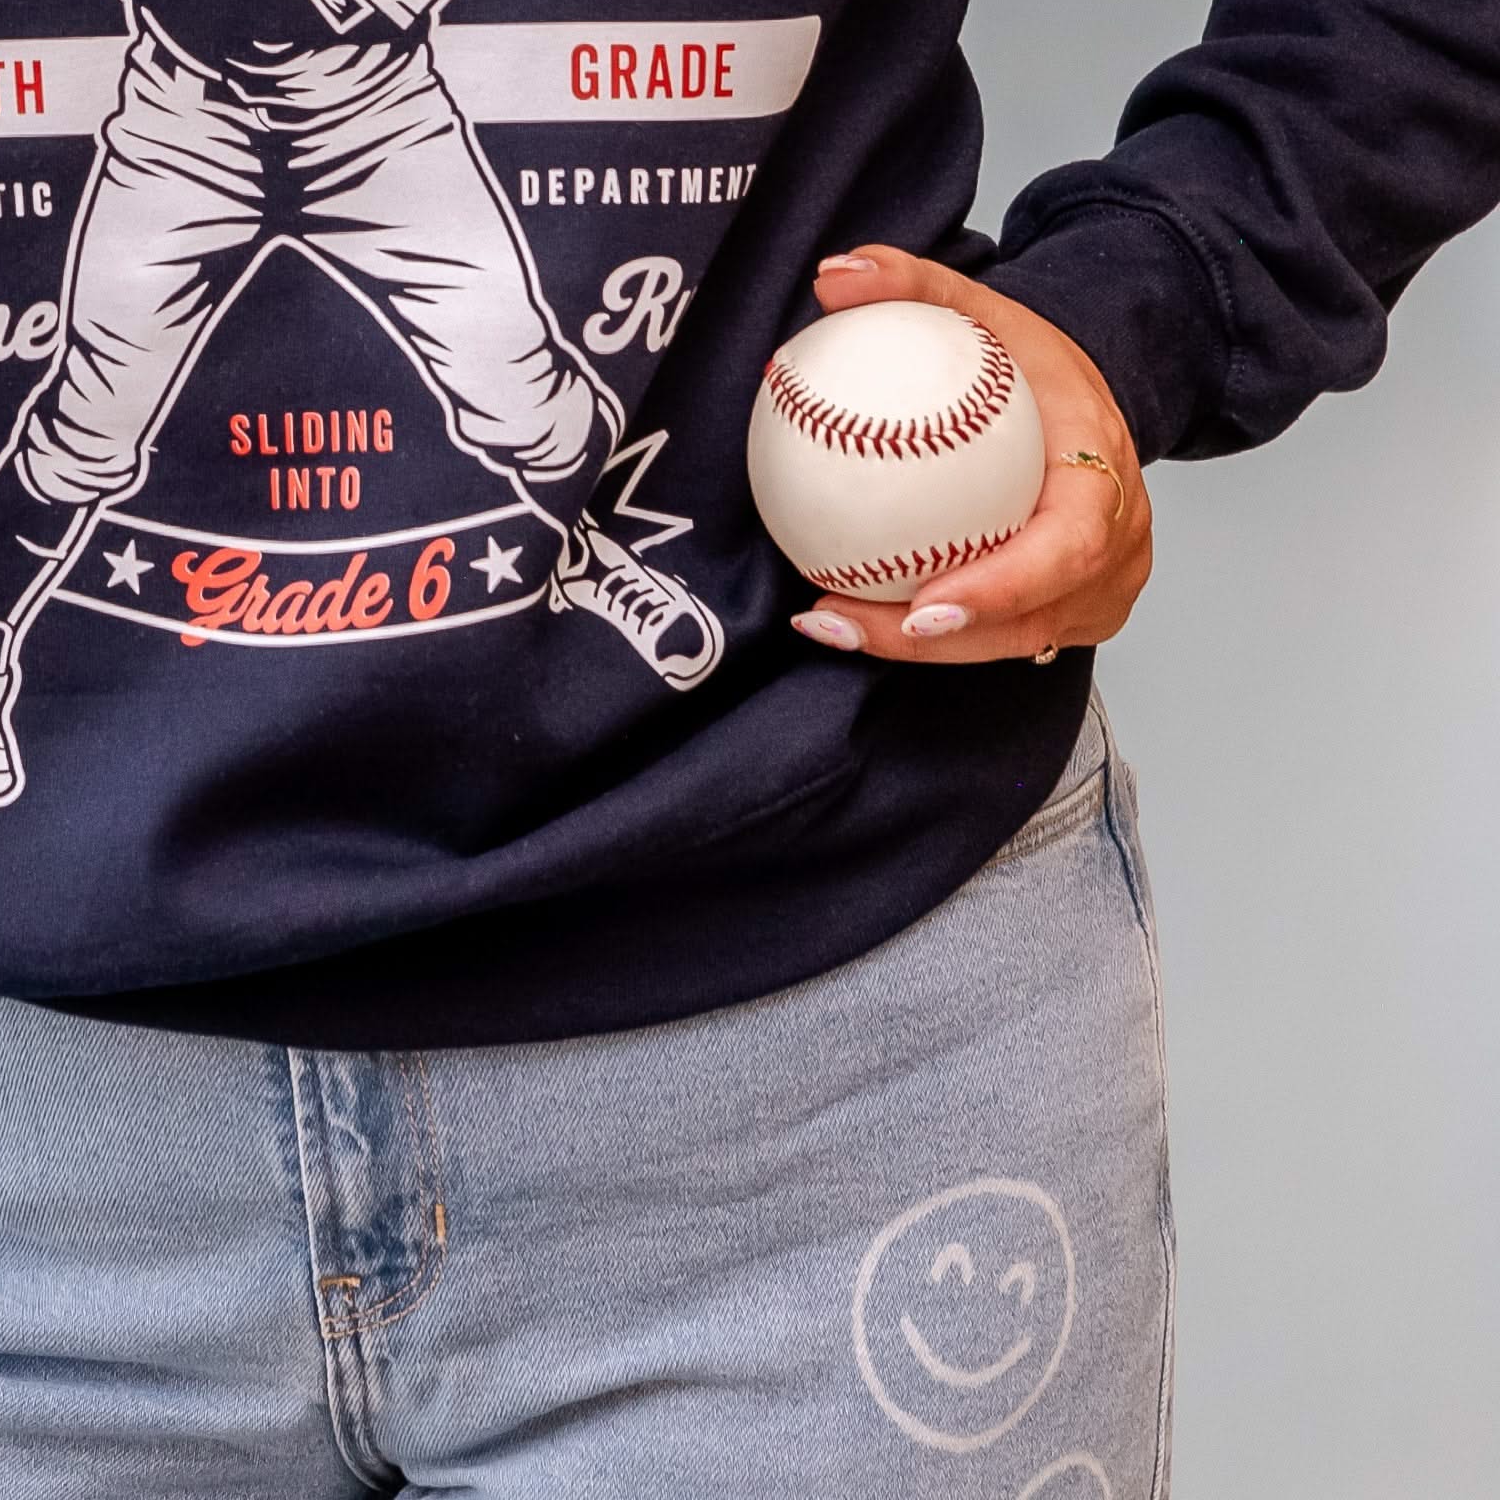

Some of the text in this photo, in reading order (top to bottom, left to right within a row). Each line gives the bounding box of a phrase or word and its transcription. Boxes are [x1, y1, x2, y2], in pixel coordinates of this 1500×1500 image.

[570, 43, 736, 100] GRADE
[230, 409, 394, 455] SLIDING
[270, 466, 361, 510] INTO
[171, 537, 456, 647] Grade 6
